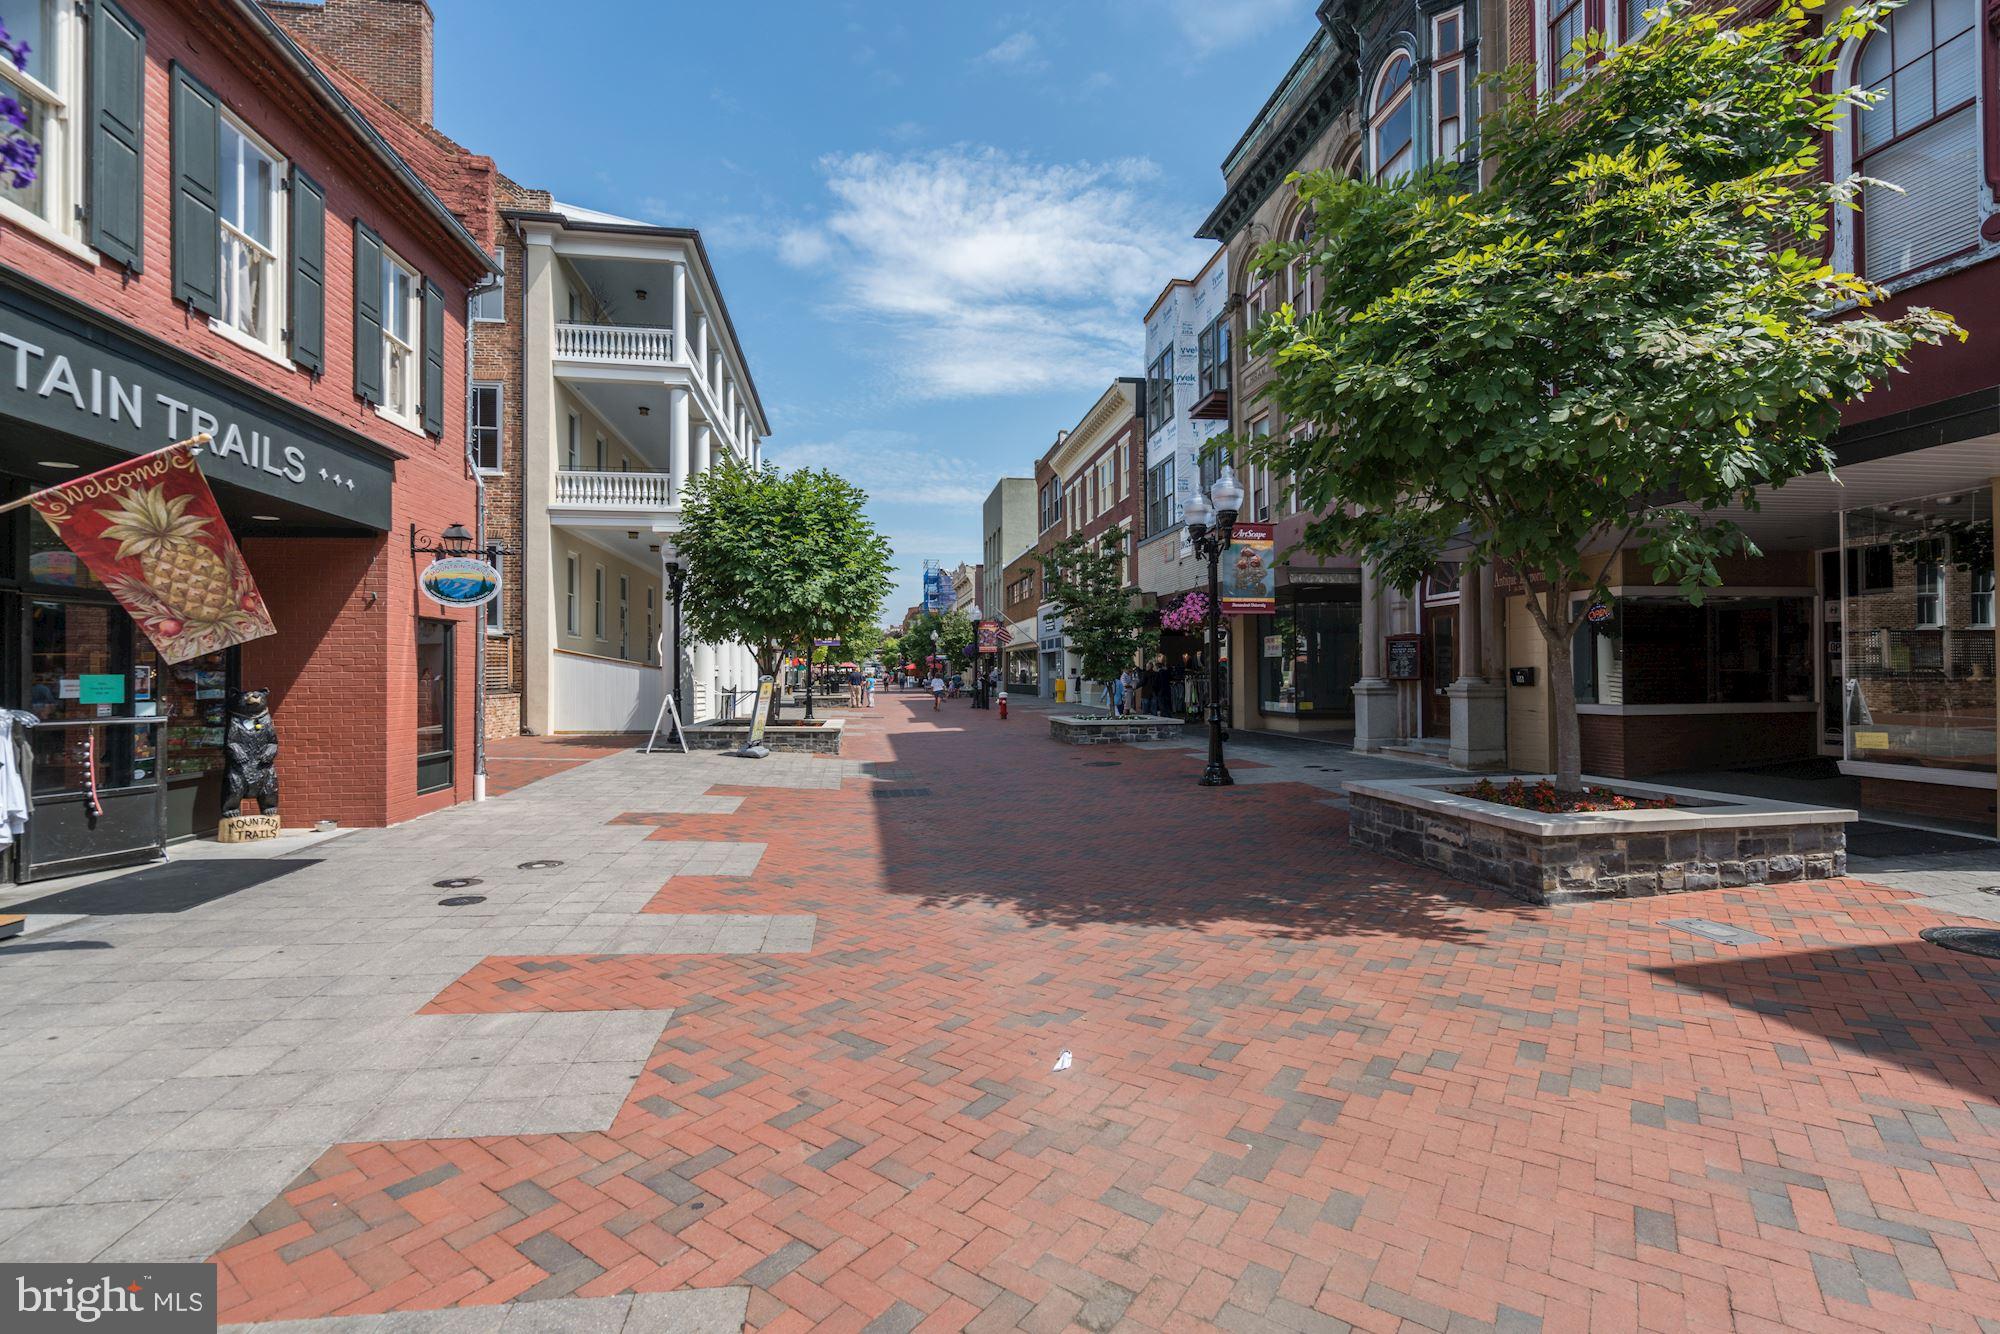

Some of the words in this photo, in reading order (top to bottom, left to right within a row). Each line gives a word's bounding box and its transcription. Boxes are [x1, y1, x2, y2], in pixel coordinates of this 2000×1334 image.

[156, 393, 306, 483] TRAILS
[56, 452, 171, 505] Welcome
[1232, 529, 1267, 539] ArtScape
[228, 817, 280, 834] MOUNTAIN
[235, 829, 277, 840] TRAILS
